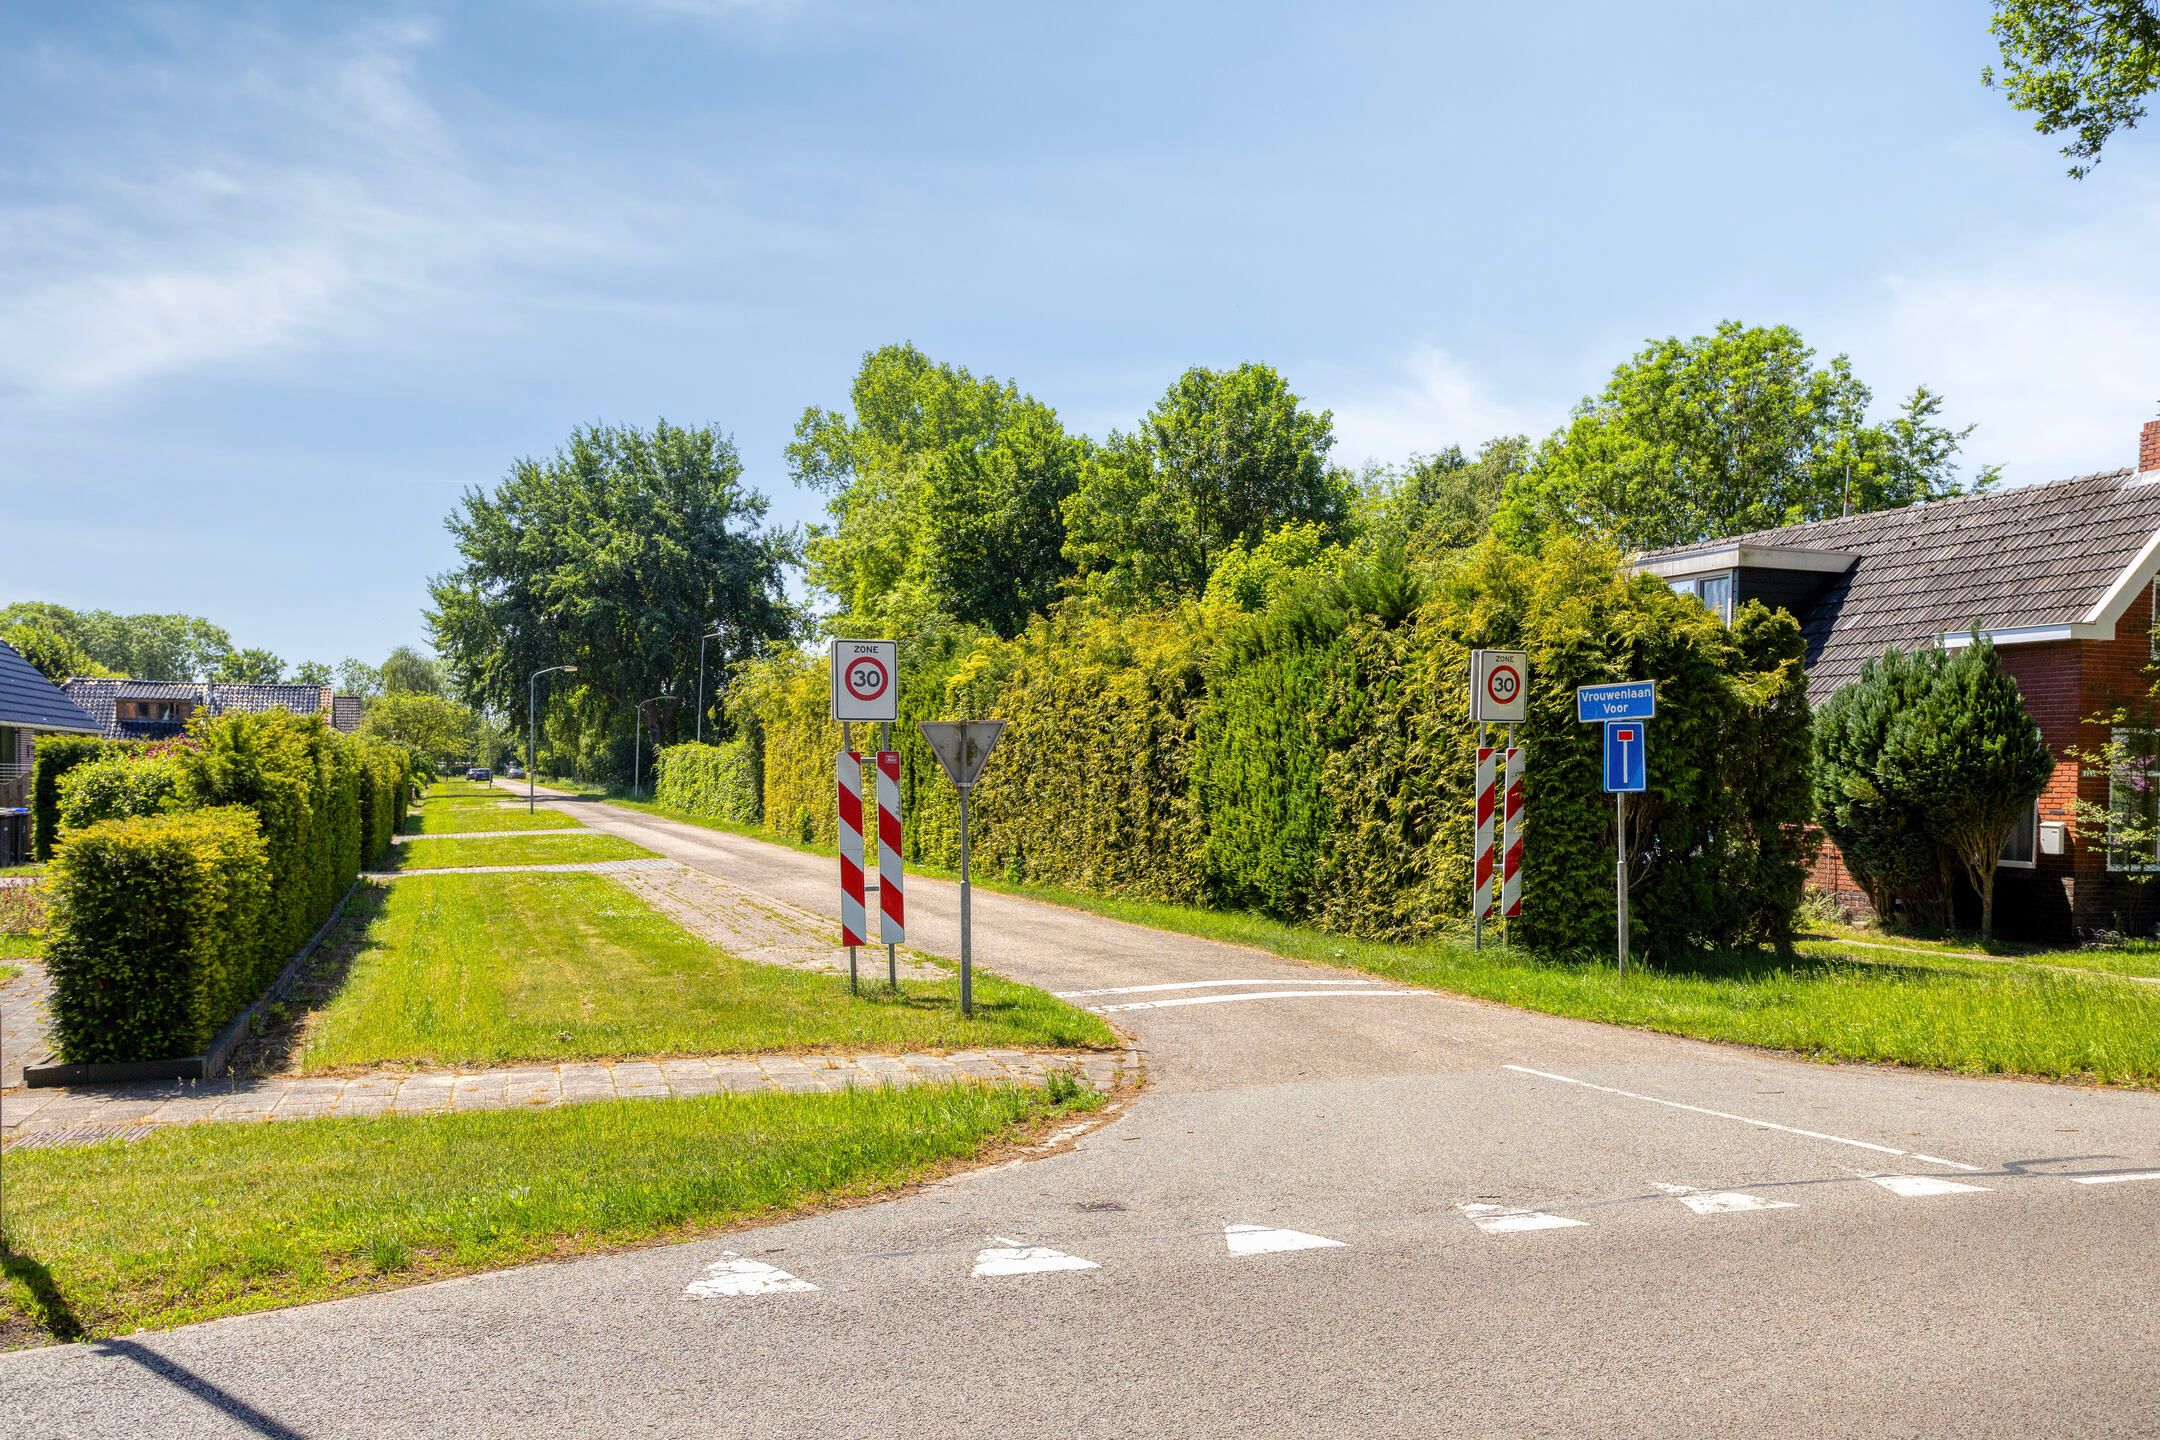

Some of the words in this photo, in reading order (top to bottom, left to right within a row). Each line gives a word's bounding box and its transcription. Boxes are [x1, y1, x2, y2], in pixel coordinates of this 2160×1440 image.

[854, 645, 879, 654] ZONE
[1495, 655, 1515, 663] ZONE
[853, 670, 880, 688] 30
[1493, 677, 1514, 693] 30
[1581, 688, 1651, 702] Vrouwenlaan
[1603, 703, 1628, 714] Voor
